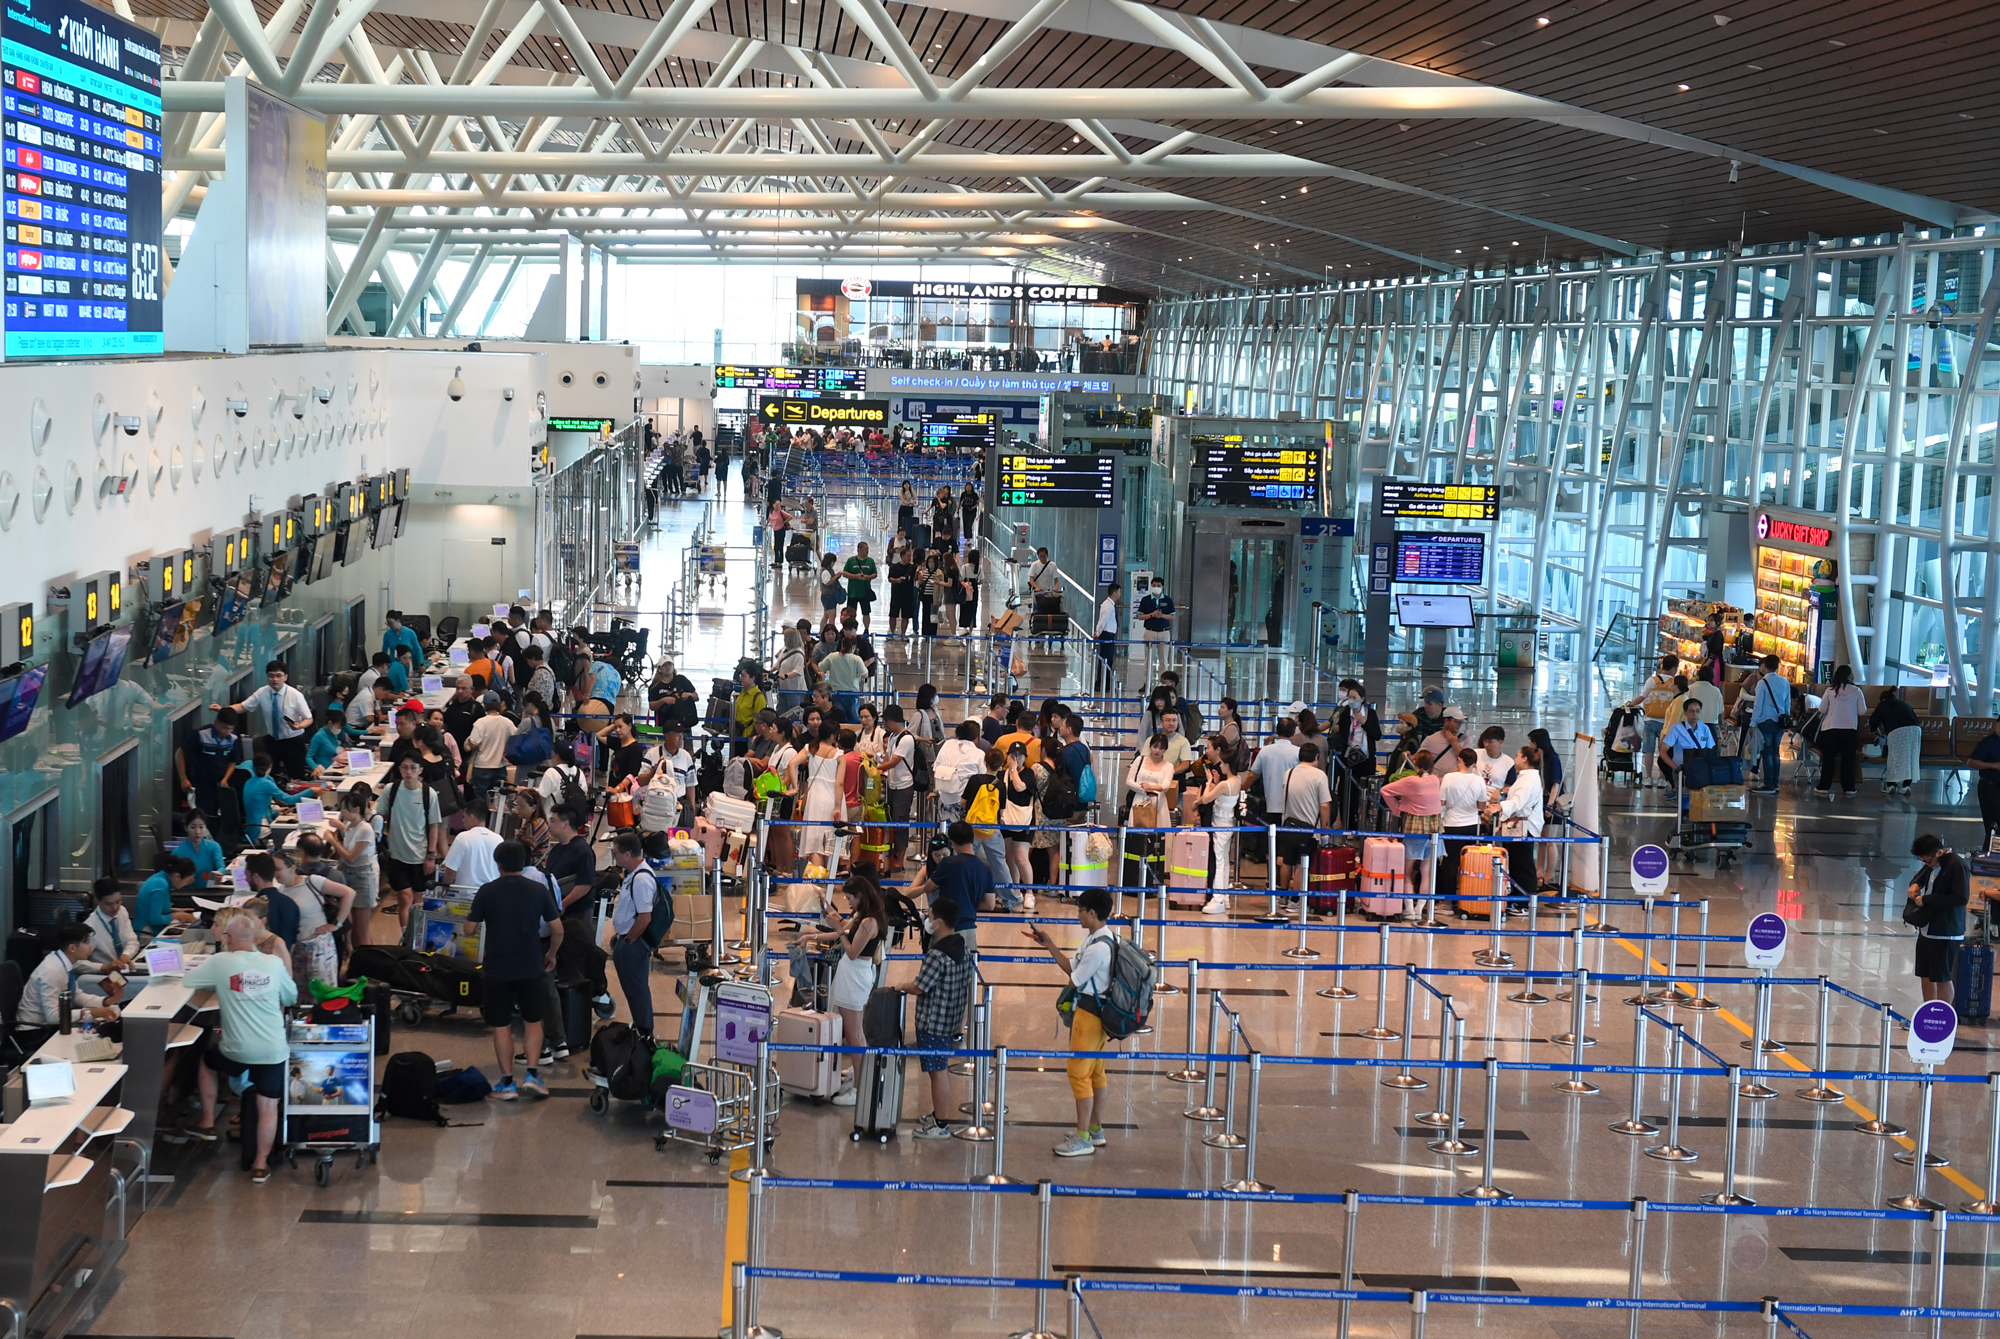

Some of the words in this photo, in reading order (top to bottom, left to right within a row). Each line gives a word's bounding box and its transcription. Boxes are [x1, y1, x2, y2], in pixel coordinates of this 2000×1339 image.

[70, 17, 94, 60] KHỞI
[96, 25, 120, 71] HÀNH
[132, 242, 158, 300] 16:02
[912, 284, 1024, 298] HIGHLANDS
[1028, 286, 1098, 300] COFFEE
[891, 376, 910, 386] Self
[912, 376, 953, 387] check-in
[961, 375, 985, 390] Quầy
[1002, 378, 1020, 388] làm
[810, 404, 884, 424] Departures
[1318, 524, 1336, 536] 2F
[1770, 520, 1794, 540] LUCKY
[1794, 524, 1810, 543] GIFT
[1810, 528, 1830, 547] SHOP
[184, 558, 192, 582] 16
[164, 566, 172, 592] 15
[110, 583, 120, 610] 14
[87, 592, 97, 620] 13
[21, 616, 32, 647] 12
[1828, 1209, 1861, 1217] International
[761, 1269, 776, 1277] Nang
[778, 1270, 814, 1278] International
[1101, 1282, 1116, 1290] Nang
[1277, 1289, 1292, 1297] Nang
[1332, 1291, 1357, 1299] Terminal
[1466, 1295, 1503, 1303] International
[1626, 1300, 1641, 1308] Nang
[1817, 1305, 1842, 1313] Terminal
[1940, 1309, 1955, 1317] Nang
[1956, 1310, 1994, 1318] International
